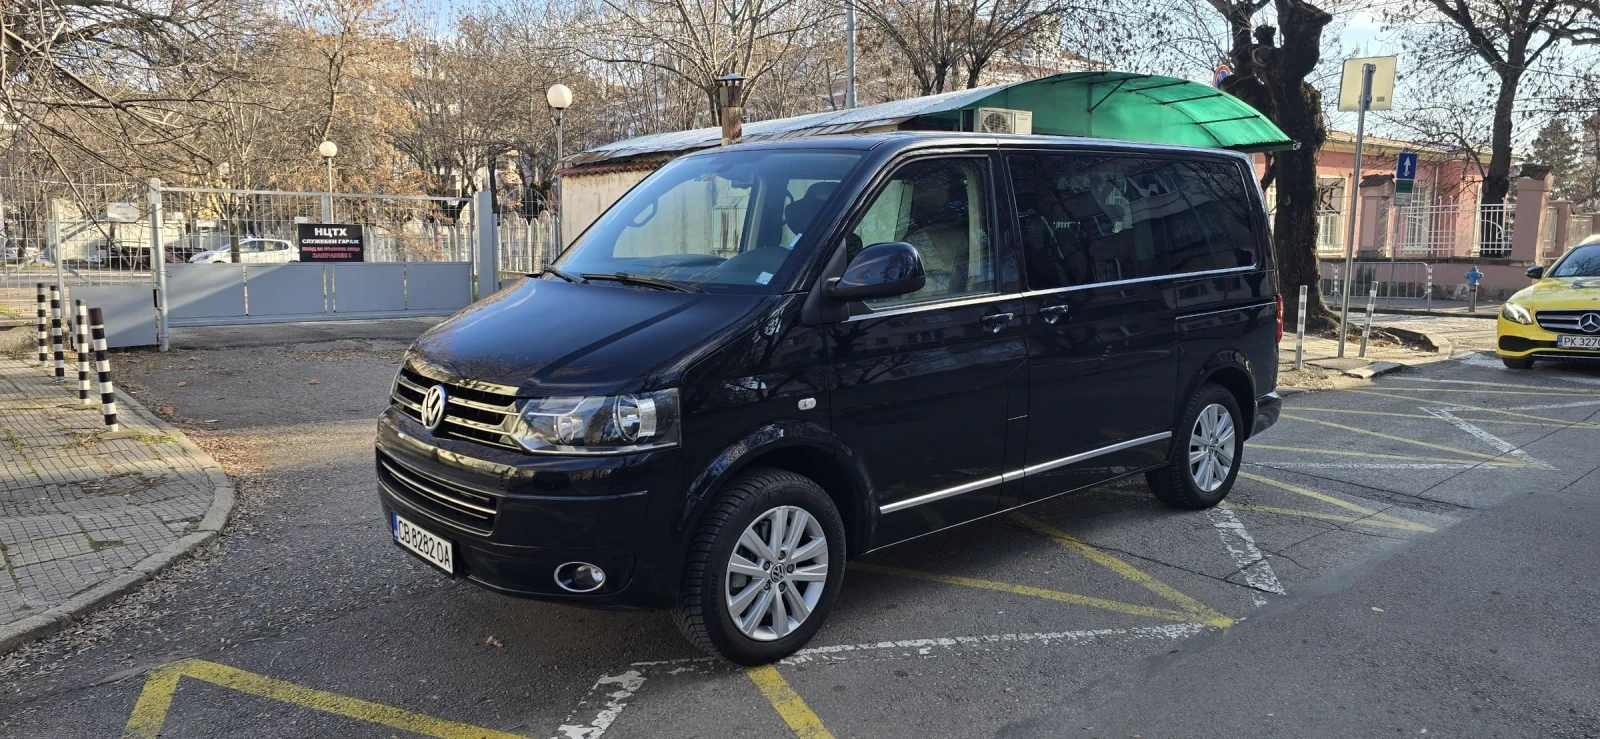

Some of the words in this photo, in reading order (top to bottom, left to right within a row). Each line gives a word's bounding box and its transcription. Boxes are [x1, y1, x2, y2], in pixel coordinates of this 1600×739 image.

[314, 227, 347, 237] НЦТХ
[1564, 337, 1576, 346] PK
[412, 527, 435, 560] 8282
